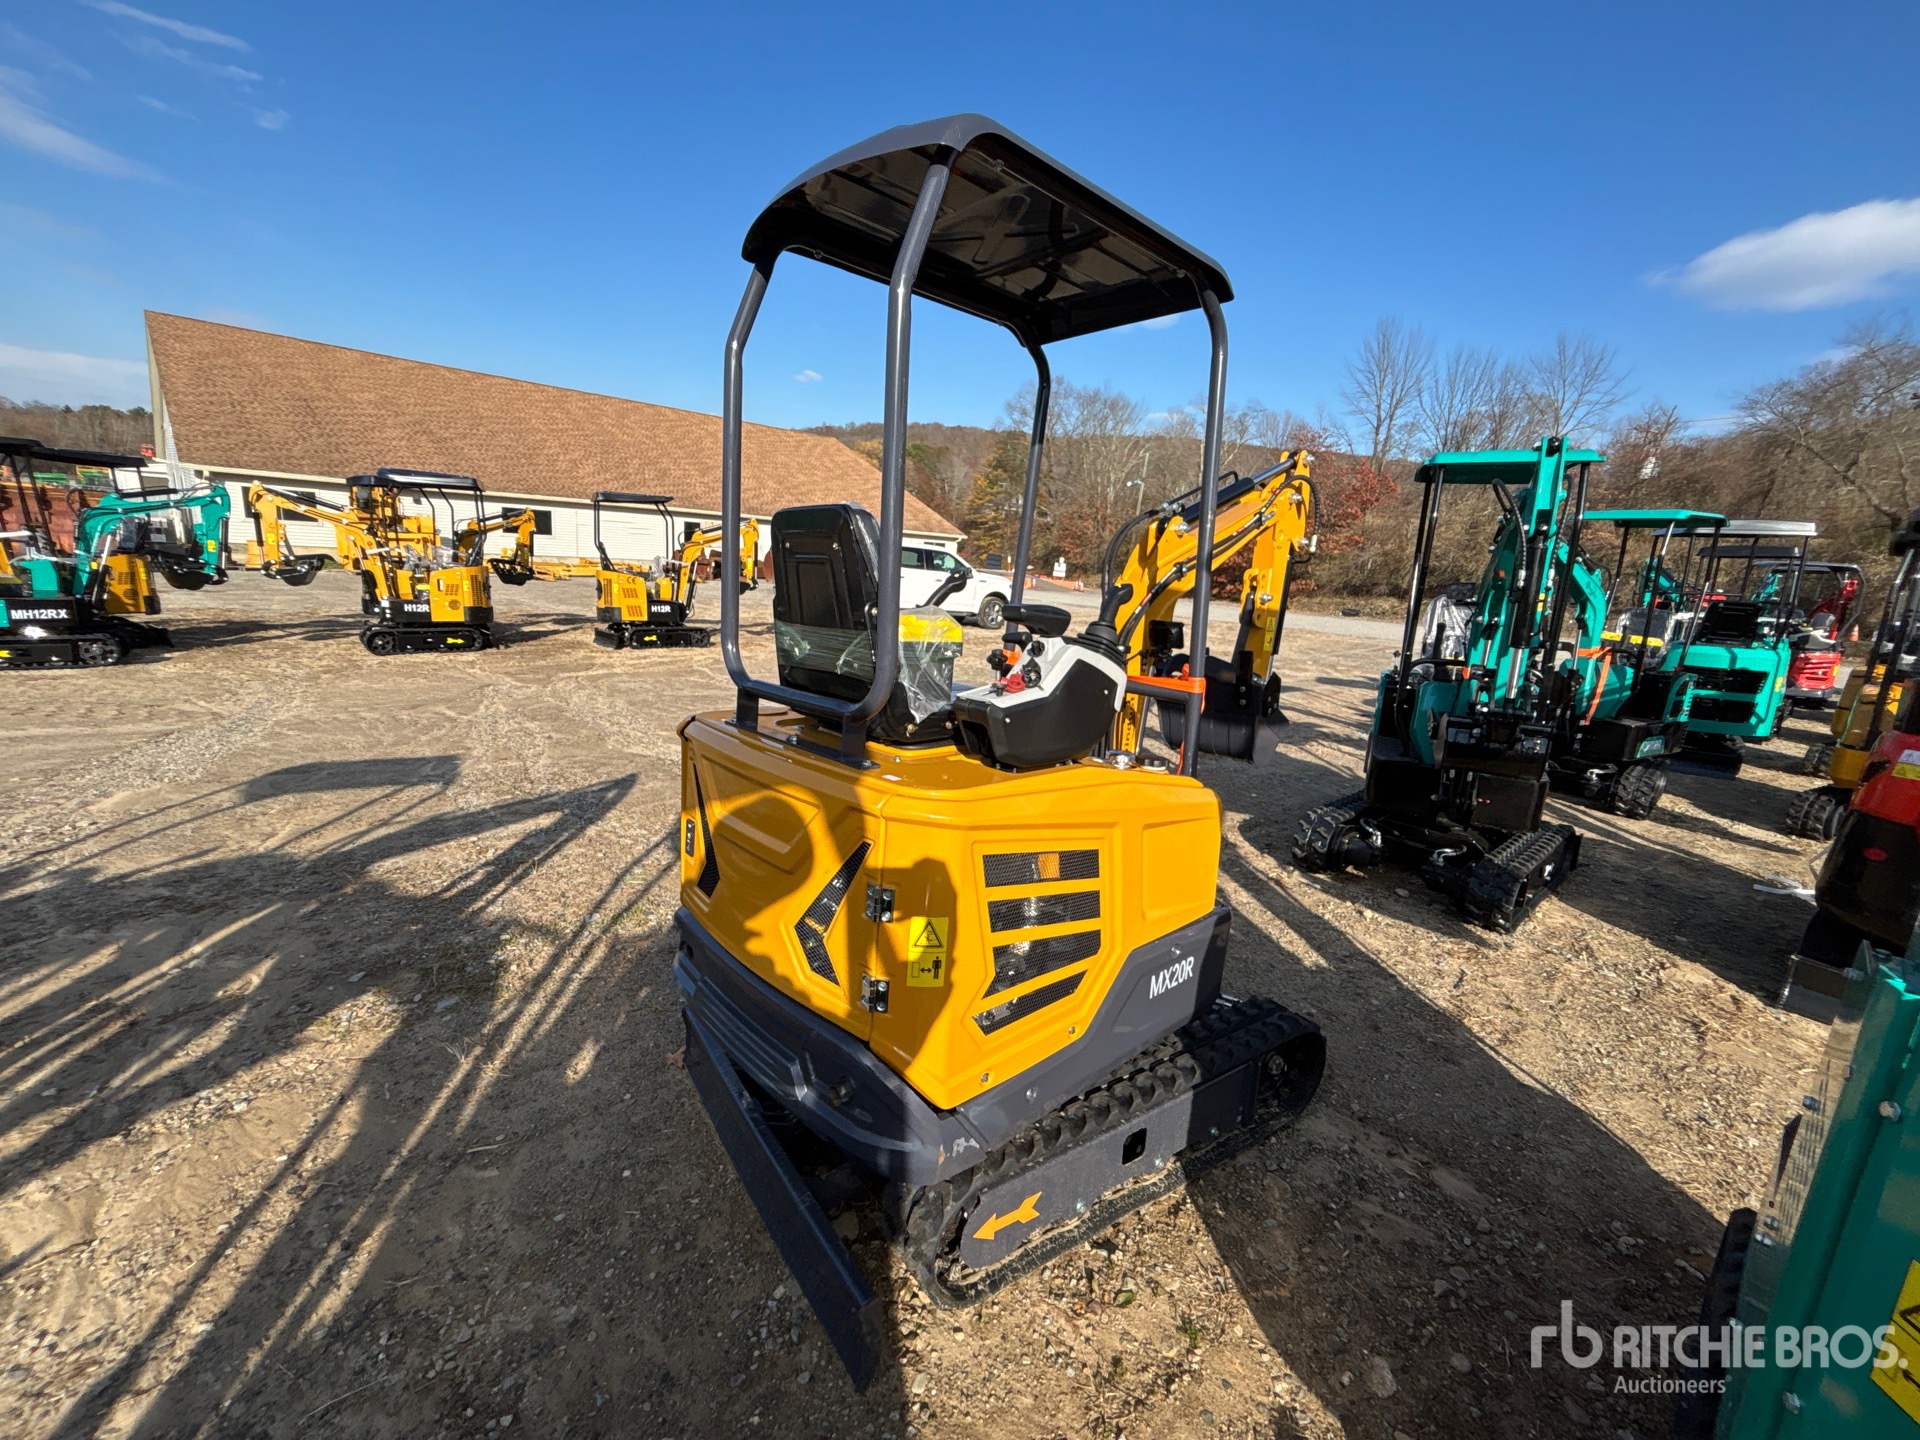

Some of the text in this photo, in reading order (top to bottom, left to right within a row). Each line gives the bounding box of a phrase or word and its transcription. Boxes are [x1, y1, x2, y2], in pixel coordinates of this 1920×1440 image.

[404, 604, 430, 612] H12R
[10, 609, 68, 619] MH12RX
[1149, 956, 1194, 999] MX20R
